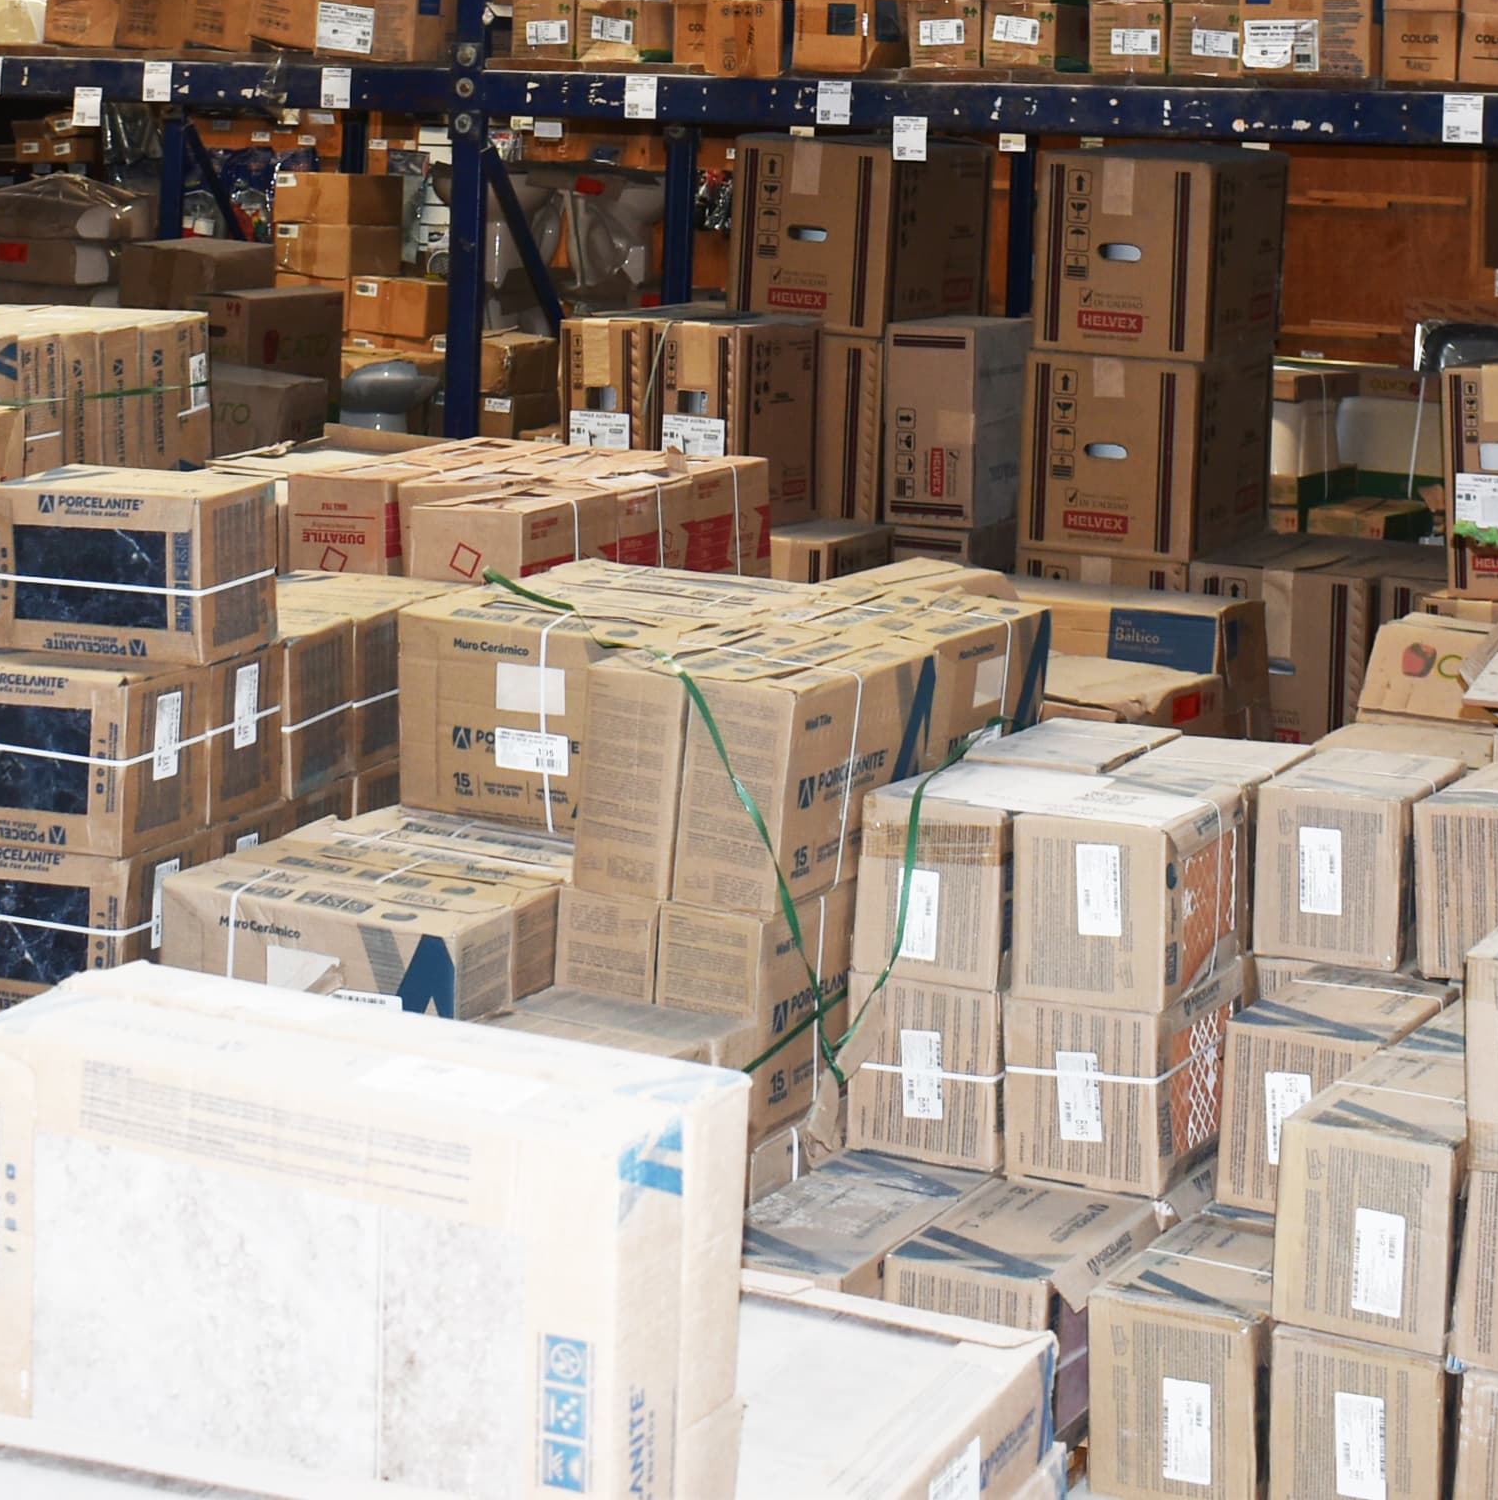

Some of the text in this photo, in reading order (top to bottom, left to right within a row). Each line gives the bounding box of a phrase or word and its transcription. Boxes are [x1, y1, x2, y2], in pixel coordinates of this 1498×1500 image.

[1401, 33, 1439, 45] COLOR
[772, 291, 823, 306] HELVEX
[1081, 314, 1138, 330] HELVEX
[932, 449, 941, 494] HELVEX
[58, 495, 140, 510] PORCELANITE
[1067, 514, 1123, 531] HELVEX
[302, 531, 366, 545] DURATILE
[1114, 626, 1160, 645] Báltico
[45, 638, 128, 656] PORCELANITE
[453, 638, 529, 657] Muro Cerámico
[805, 713, 832, 731] Wall Tile
[453, 772, 471, 788] 15
[818, 750, 885, 792] PORCELANITE
[794, 846, 808, 866] 15
[250, 920, 301, 940] Cerámico
[770, 1070, 784, 1093] 15
